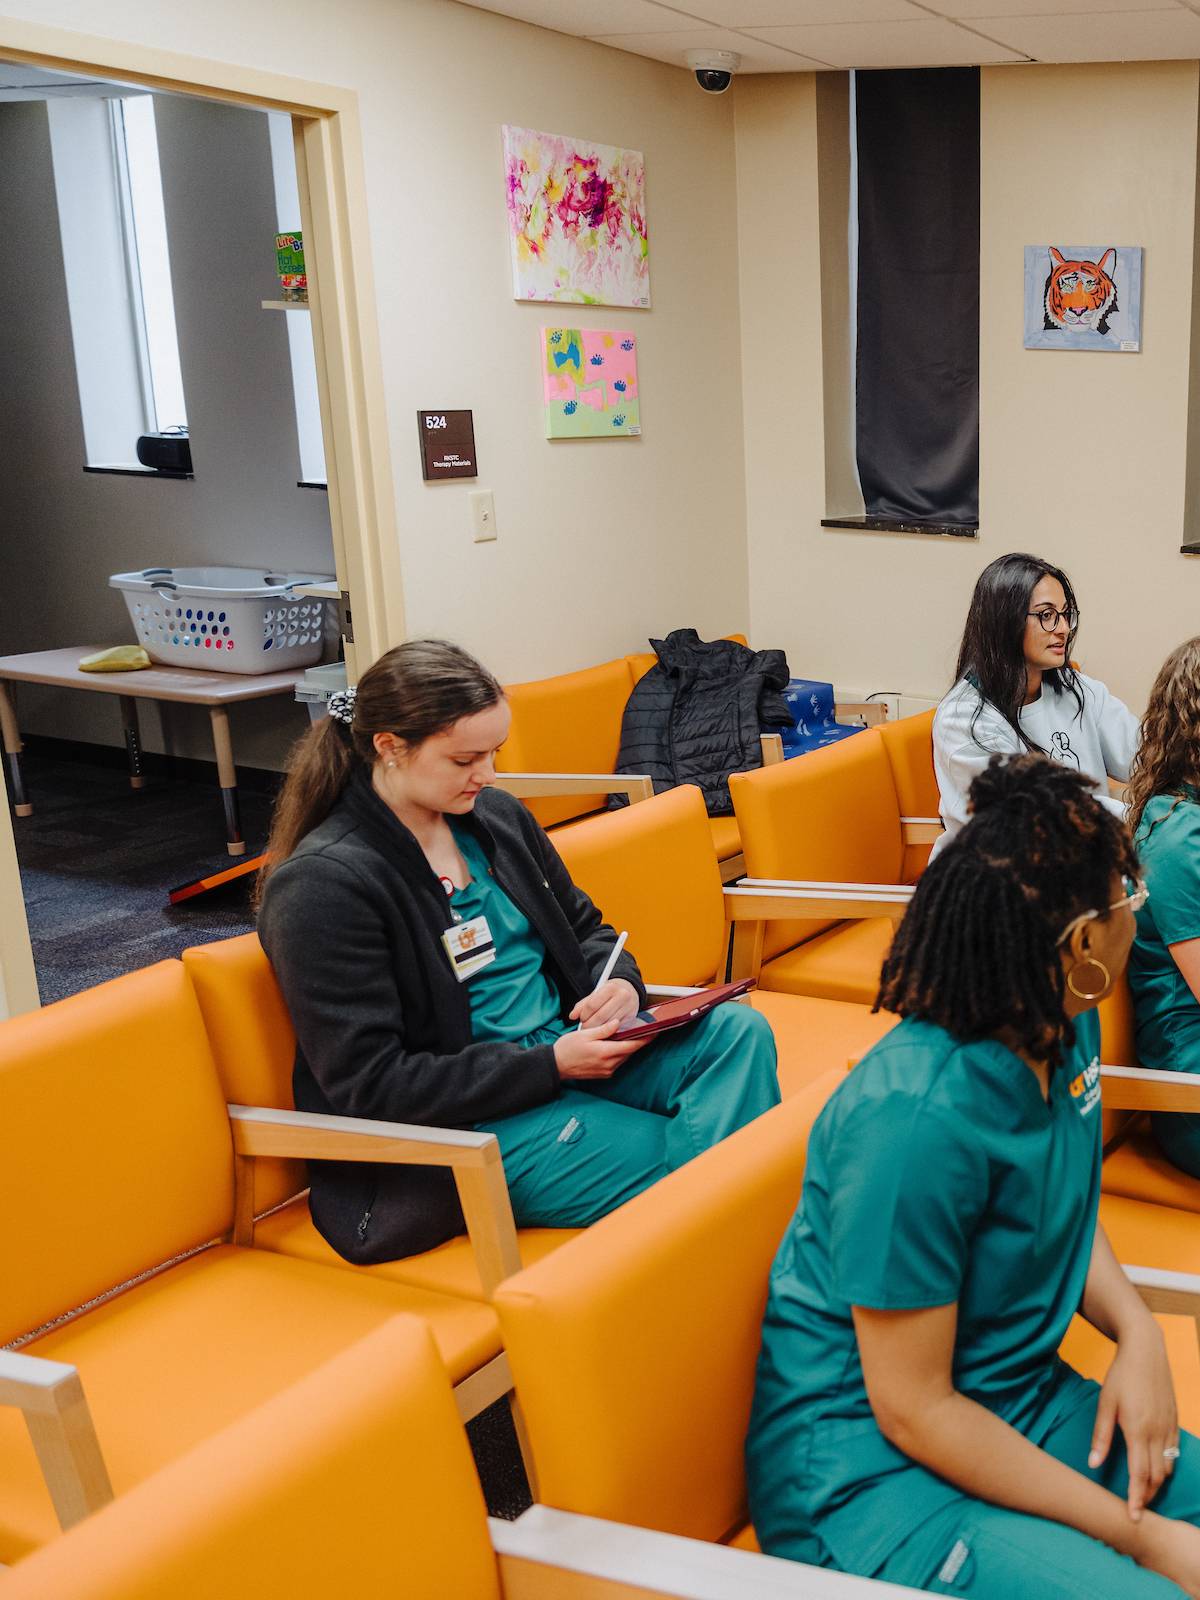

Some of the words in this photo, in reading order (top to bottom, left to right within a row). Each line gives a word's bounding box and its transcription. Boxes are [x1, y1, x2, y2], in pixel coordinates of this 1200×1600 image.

[277, 236, 294, 249] Lite
[293, 240, 303, 251] Br
[425, 415, 447, 429] 524
[451, 459, 472, 467] Materials
